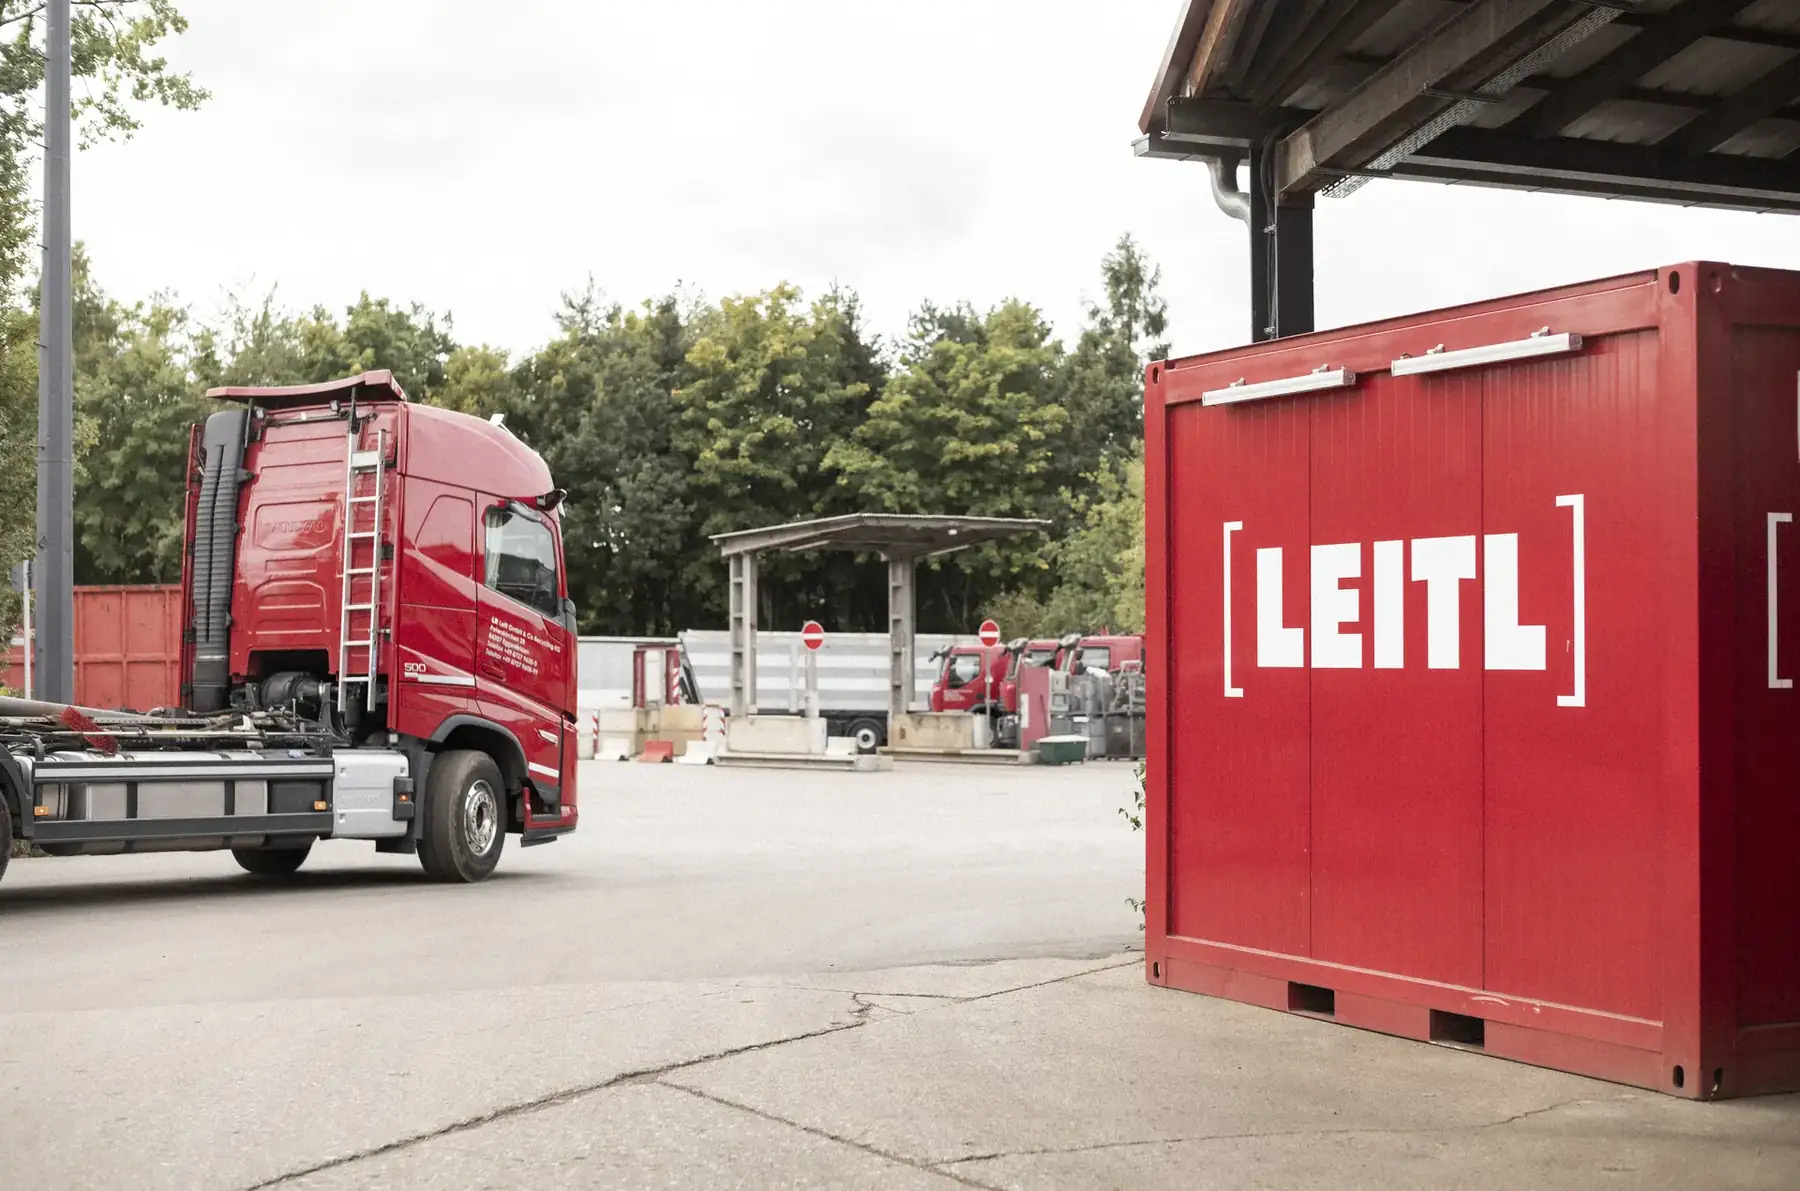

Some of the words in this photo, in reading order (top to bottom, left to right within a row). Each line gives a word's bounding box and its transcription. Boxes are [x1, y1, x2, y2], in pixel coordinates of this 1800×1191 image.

[508, 624, 523, 635] GmbH
[555, 645, 561, 653] KG
[404, 663, 426, 672] 500
